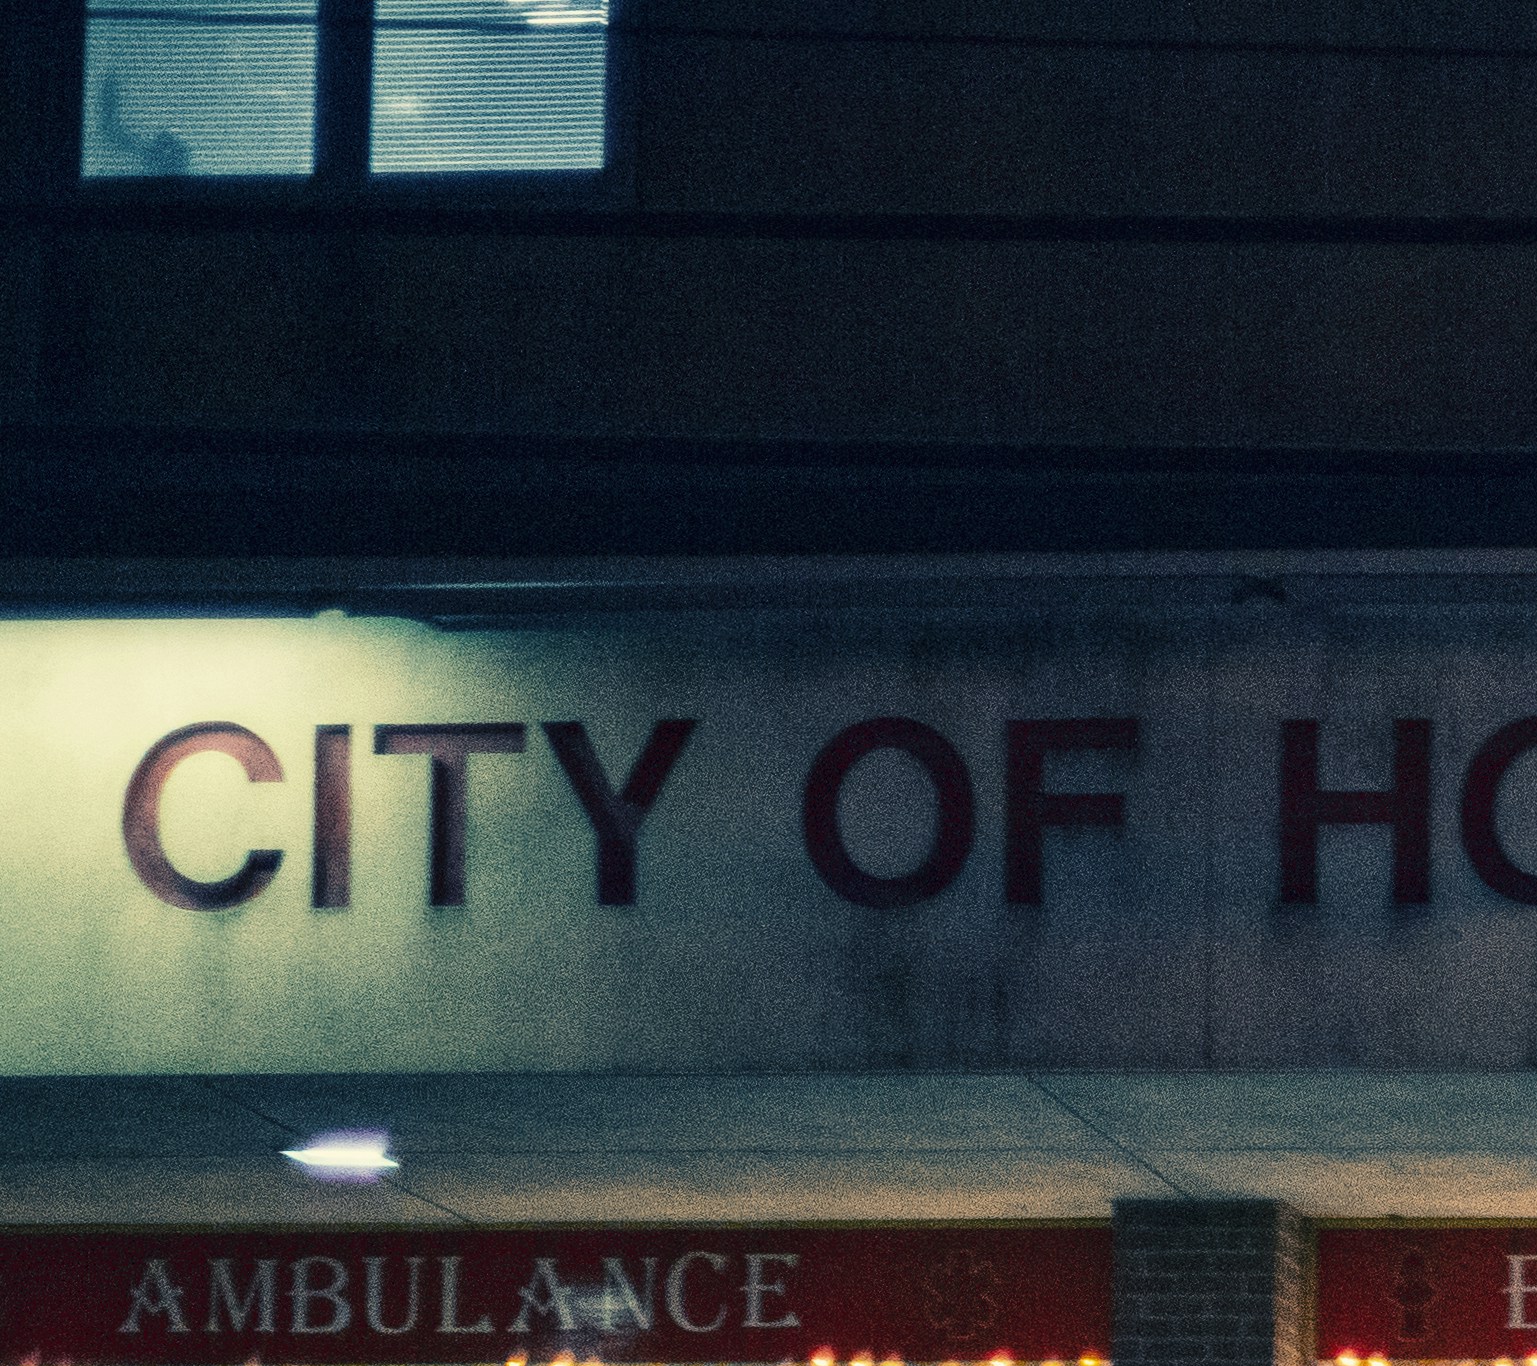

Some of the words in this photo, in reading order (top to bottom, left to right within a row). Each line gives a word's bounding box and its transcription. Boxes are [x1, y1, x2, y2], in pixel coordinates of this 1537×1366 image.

[120, 718, 699, 911] CITY
[800, 714, 1139, 909] OF
[120, 1250, 802, 1336] AMBULANCE
